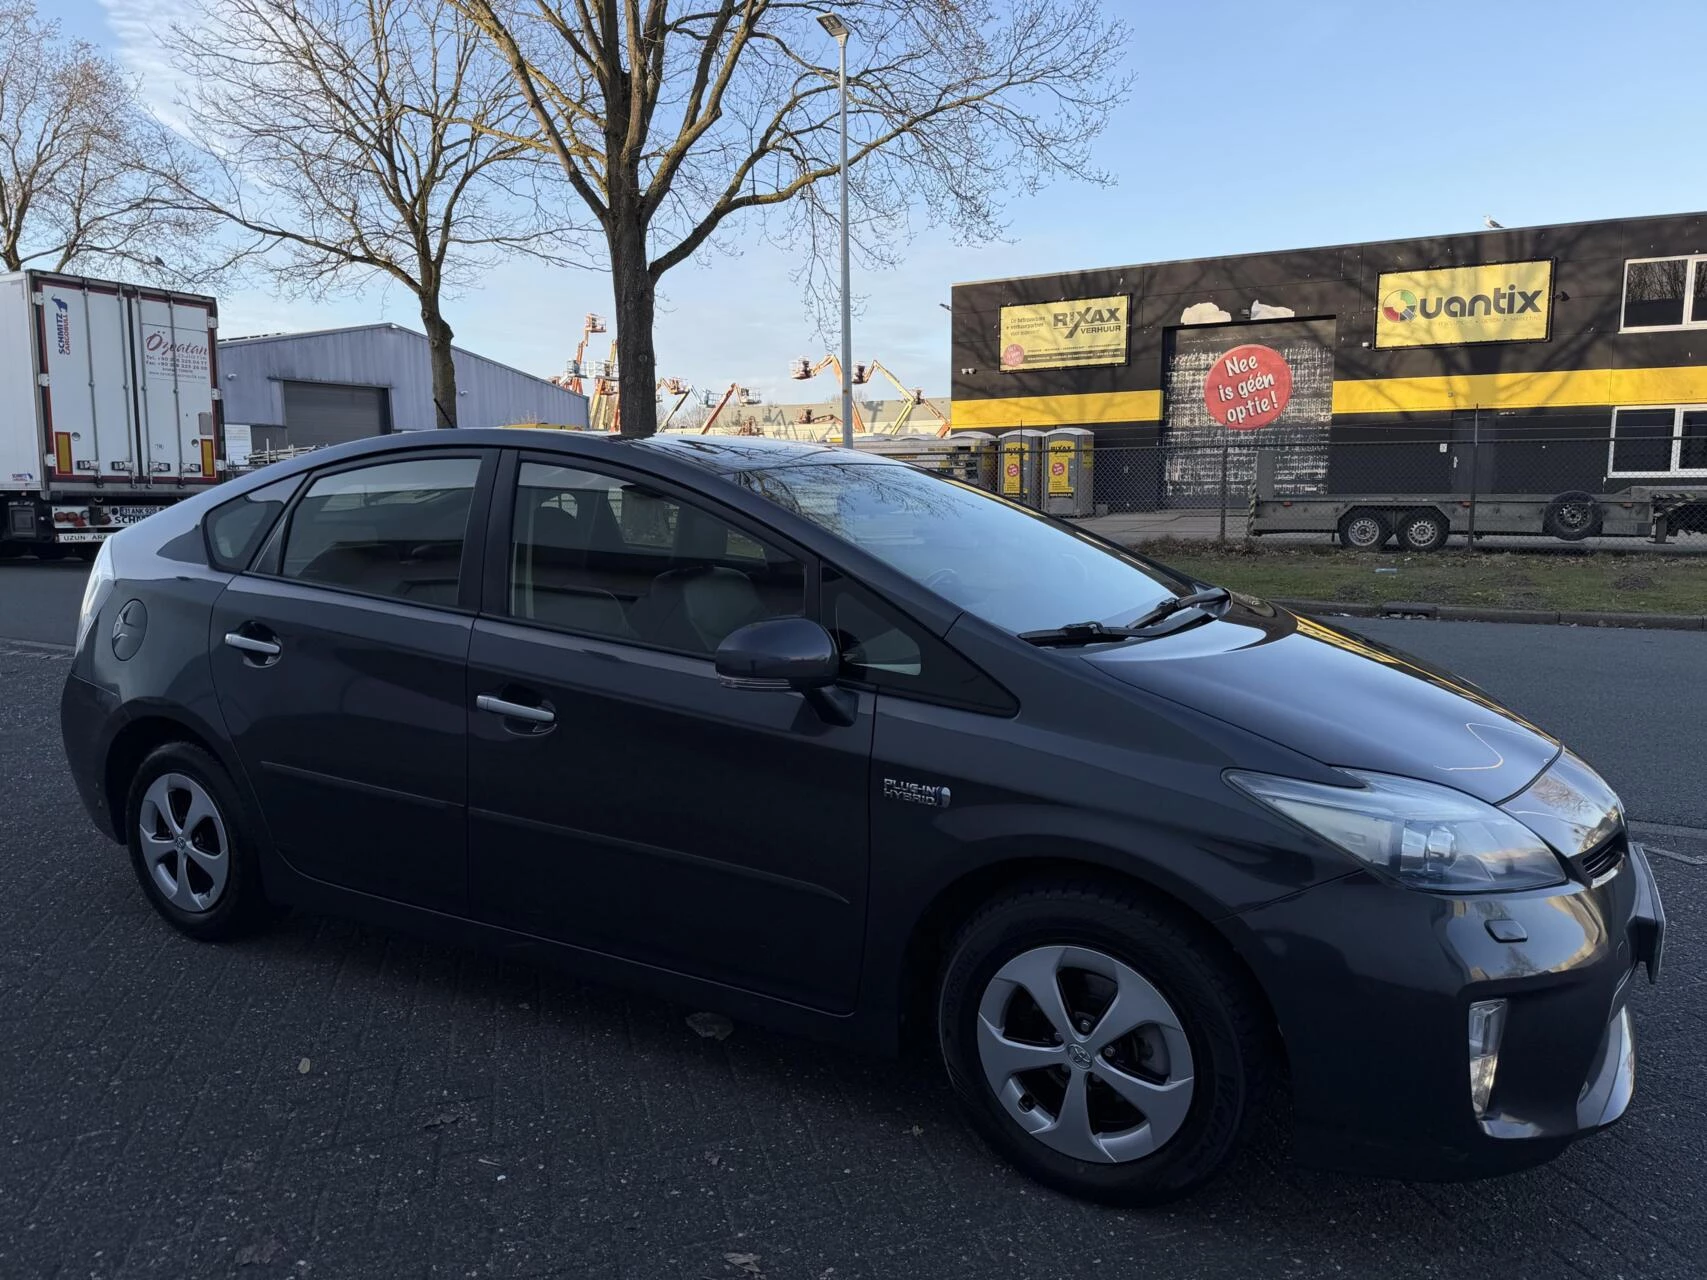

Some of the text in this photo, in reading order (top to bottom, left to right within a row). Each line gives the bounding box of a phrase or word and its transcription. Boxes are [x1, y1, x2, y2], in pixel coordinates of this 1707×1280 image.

[1382, 284, 1543, 323] Quantix
[56, 312, 65, 355] SCHMITZ
[1080, 325, 1121, 335] VERHUUR
[1225, 355, 1258, 377] Nee
[1218, 372, 1275, 402] is géén
[1226, 390, 1278, 423] optie!
[884, 778, 938, 796] PLUG-IN
[884, 788, 938, 807] HYBRID
